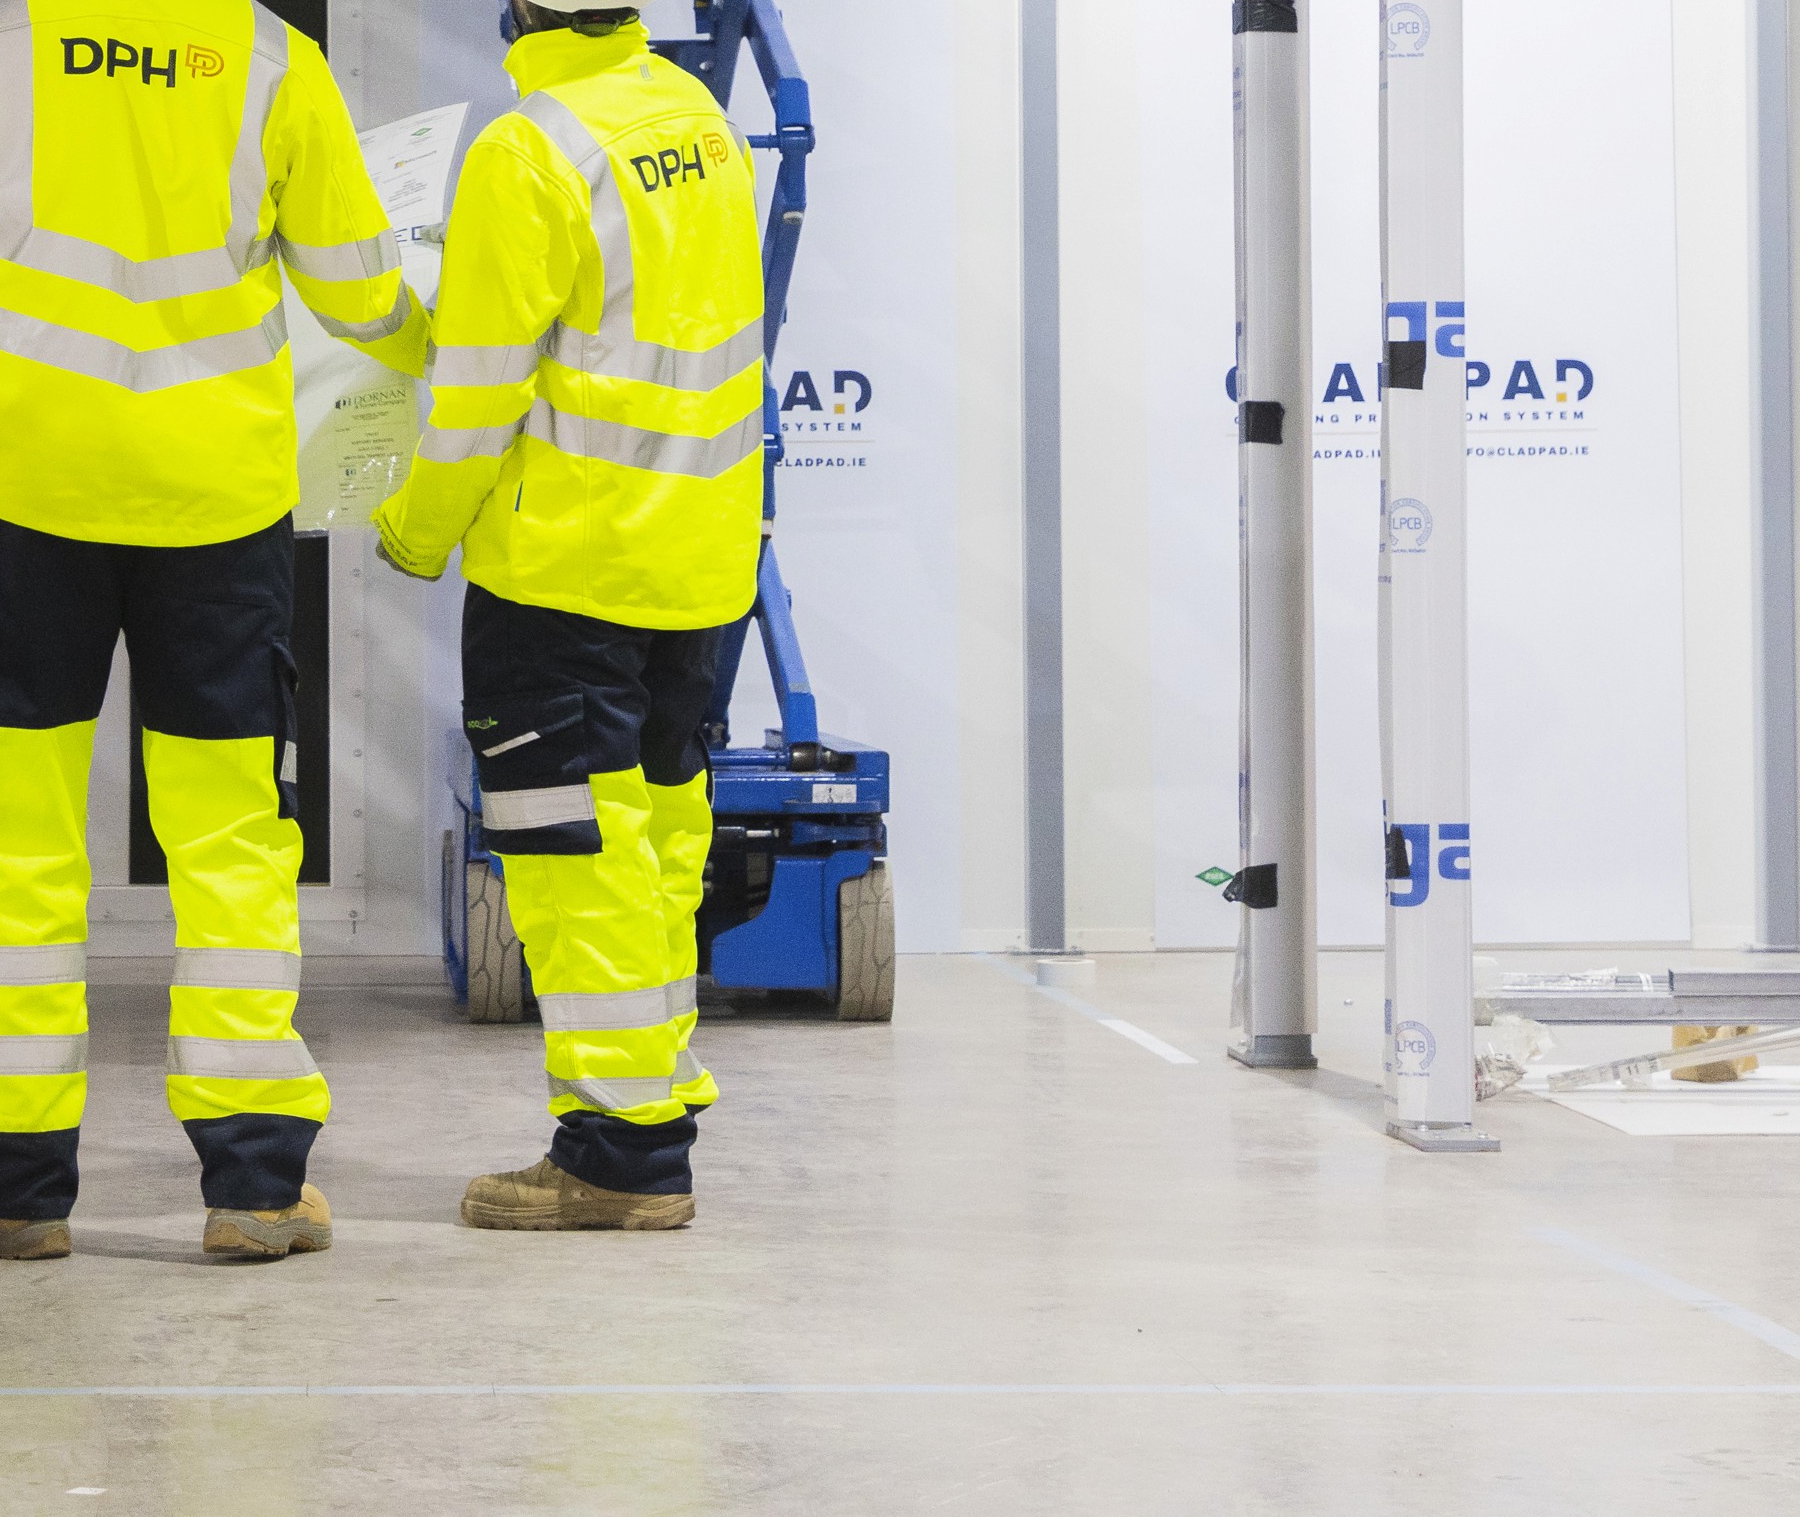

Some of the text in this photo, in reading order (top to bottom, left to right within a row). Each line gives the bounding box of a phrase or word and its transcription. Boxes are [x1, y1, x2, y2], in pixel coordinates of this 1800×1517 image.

[59, 37, 178, 89] DPH
[629, 143, 706, 193] DPH
[1503, 409, 1585, 422] SYSTEM
[781, 421, 862, 433] SYSTEM
[1392, 516, 1422, 530] LPCB
[1396, 1040, 1426, 1053] LPCB
